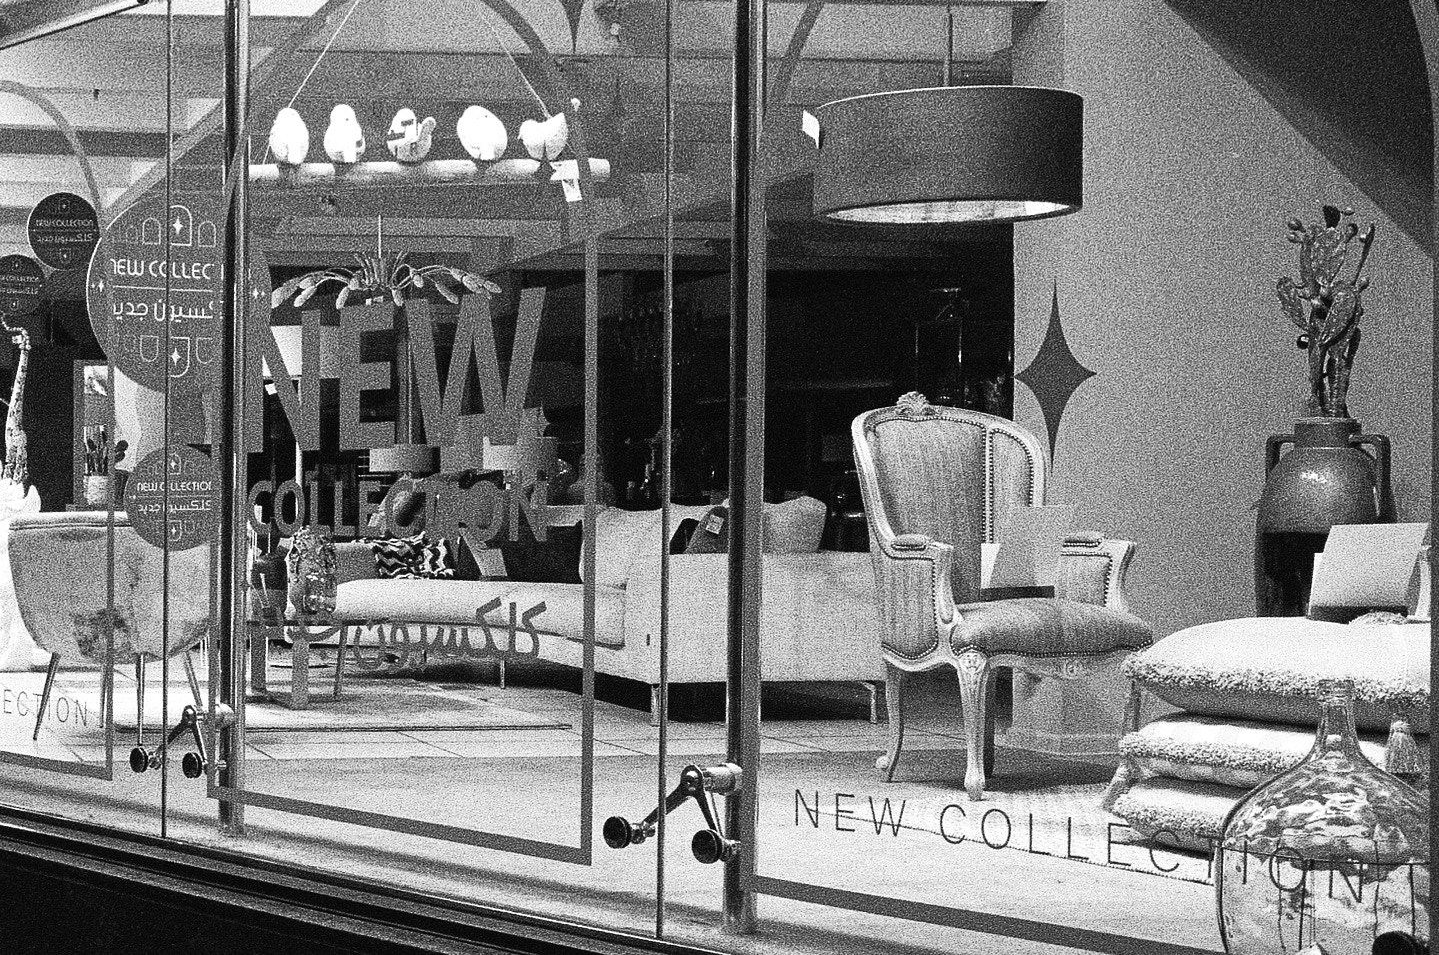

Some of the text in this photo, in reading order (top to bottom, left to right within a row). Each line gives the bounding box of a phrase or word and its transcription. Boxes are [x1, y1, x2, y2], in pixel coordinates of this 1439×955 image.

[243, 287, 547, 454] NEW
[247, 477, 548, 543] COLLECTION
[794, 788, 1363, 904] NEW COLLECTION
